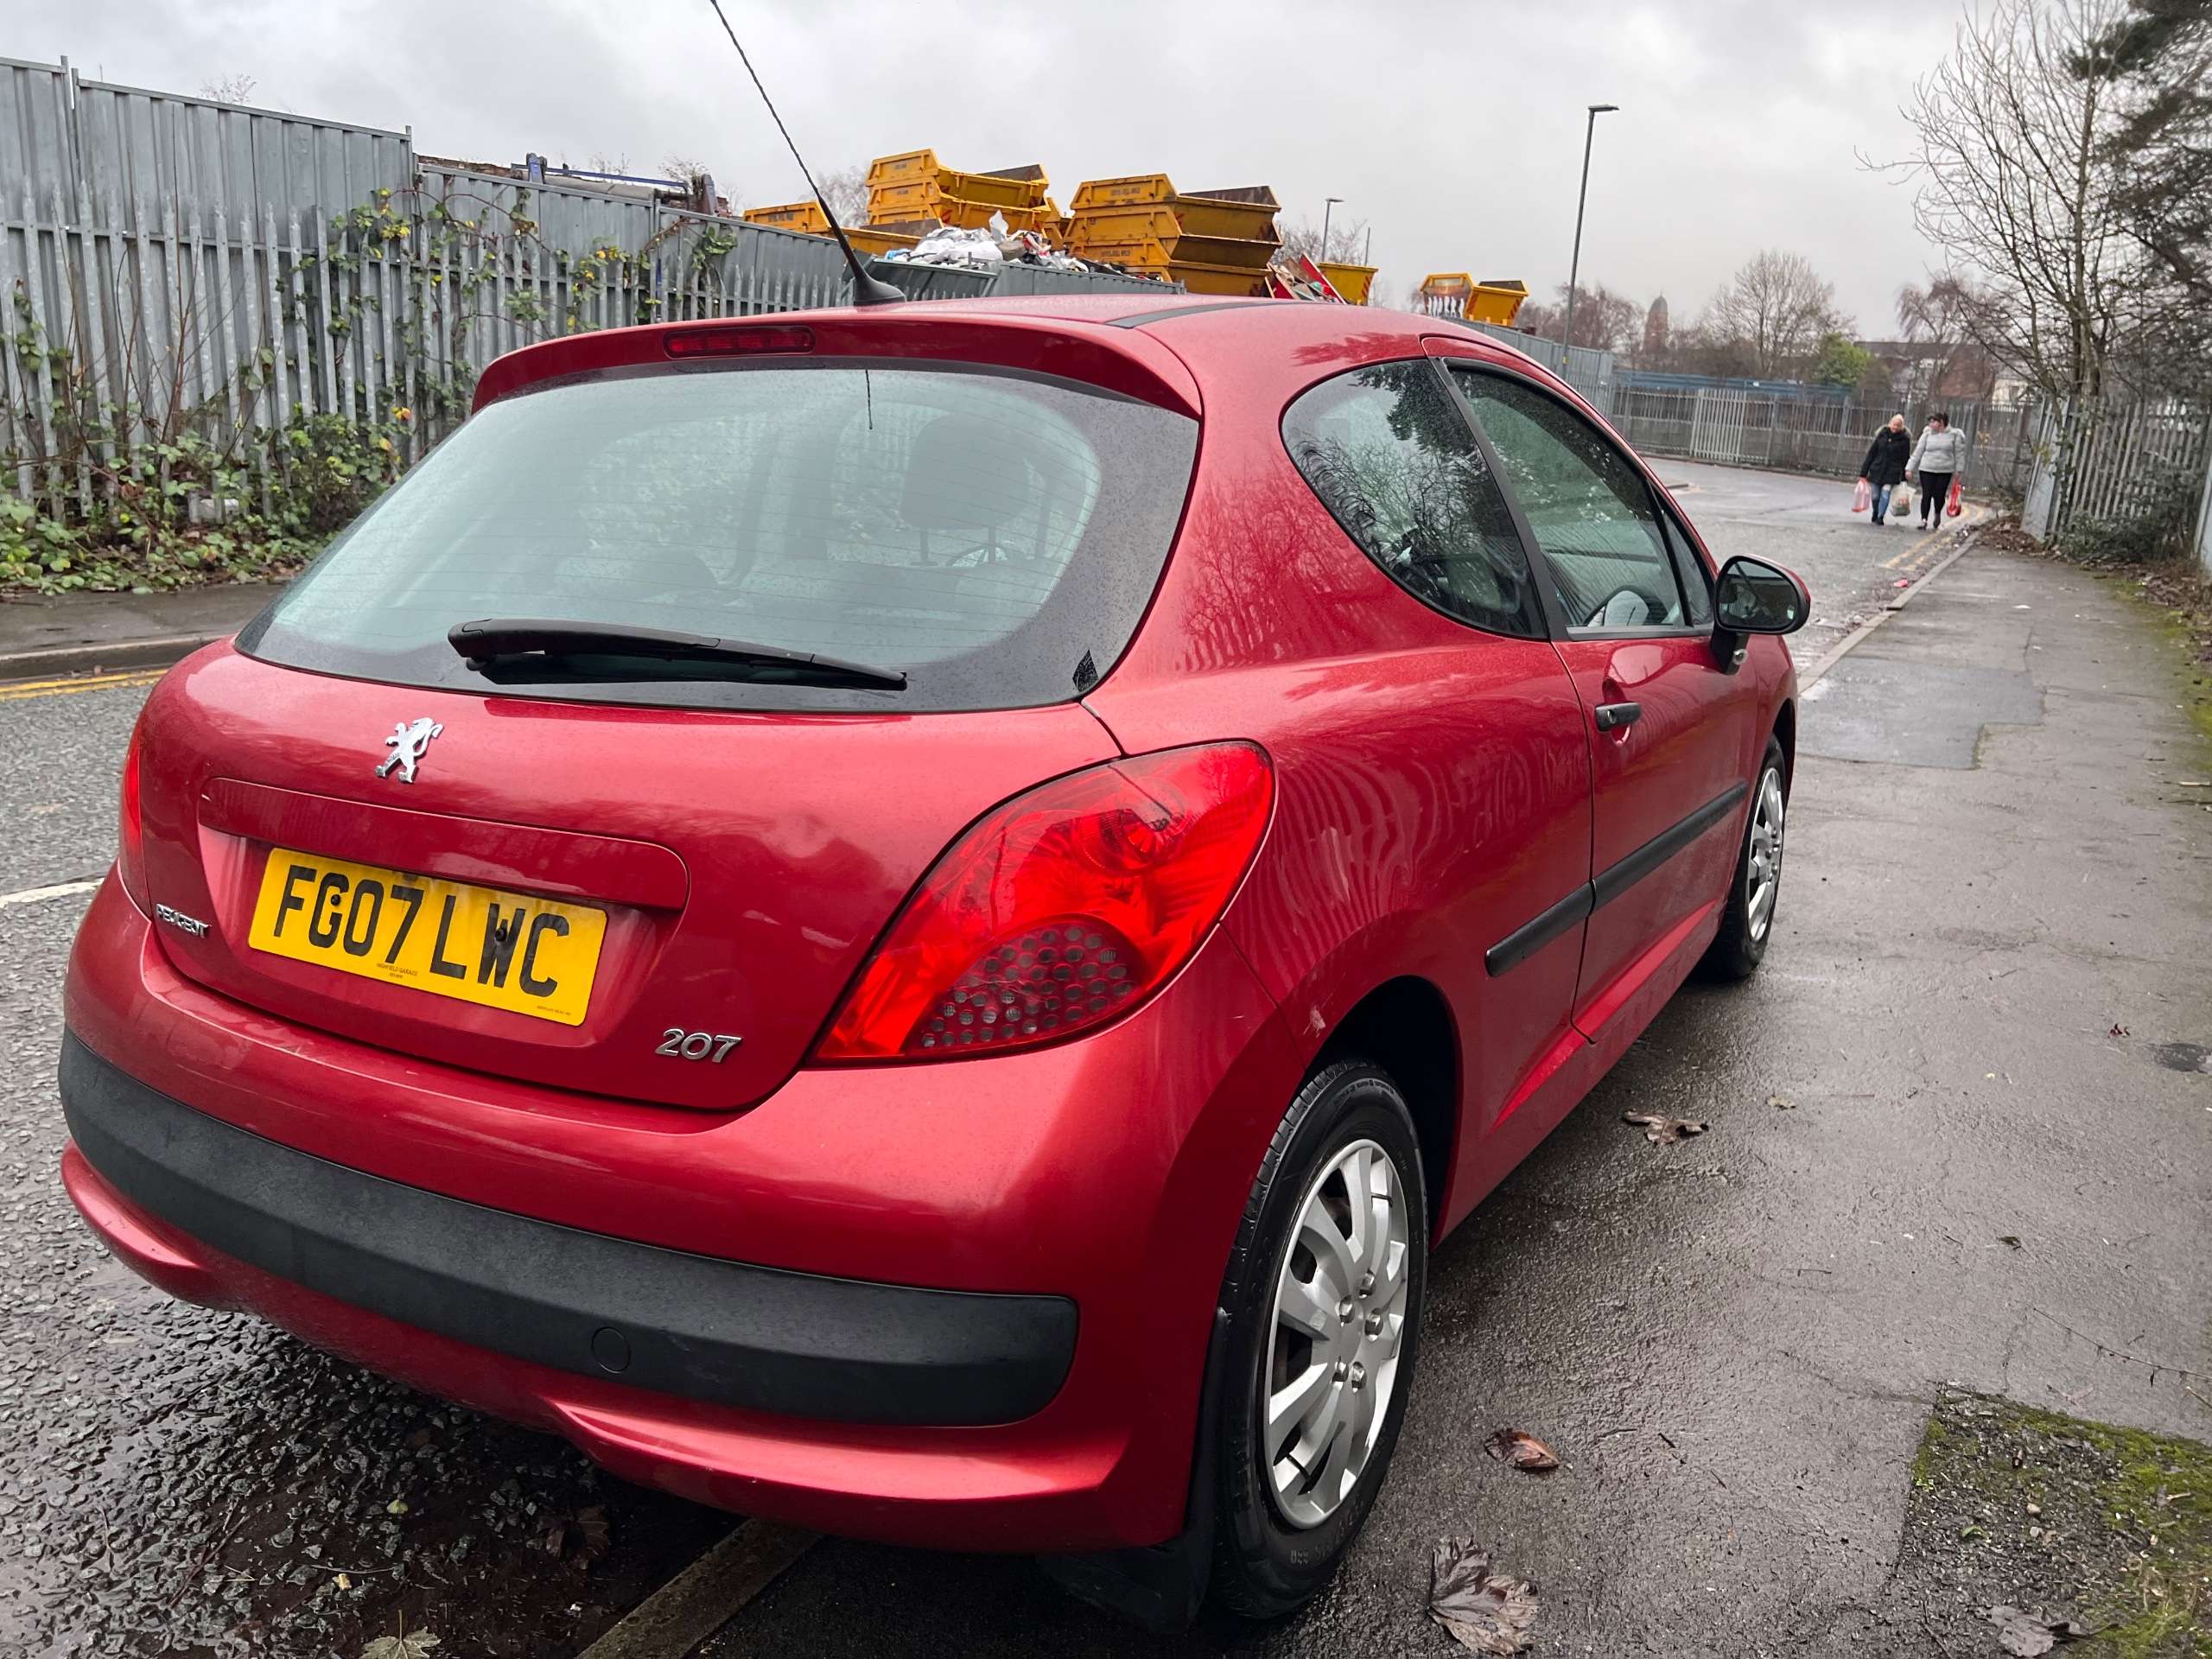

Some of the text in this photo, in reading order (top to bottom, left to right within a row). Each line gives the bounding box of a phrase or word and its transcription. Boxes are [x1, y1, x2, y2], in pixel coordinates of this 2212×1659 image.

[156, 903, 210, 938] PEUGEOT
[273, 866, 570, 997] FG07 LWC
[655, 1027, 742, 1064] 207
